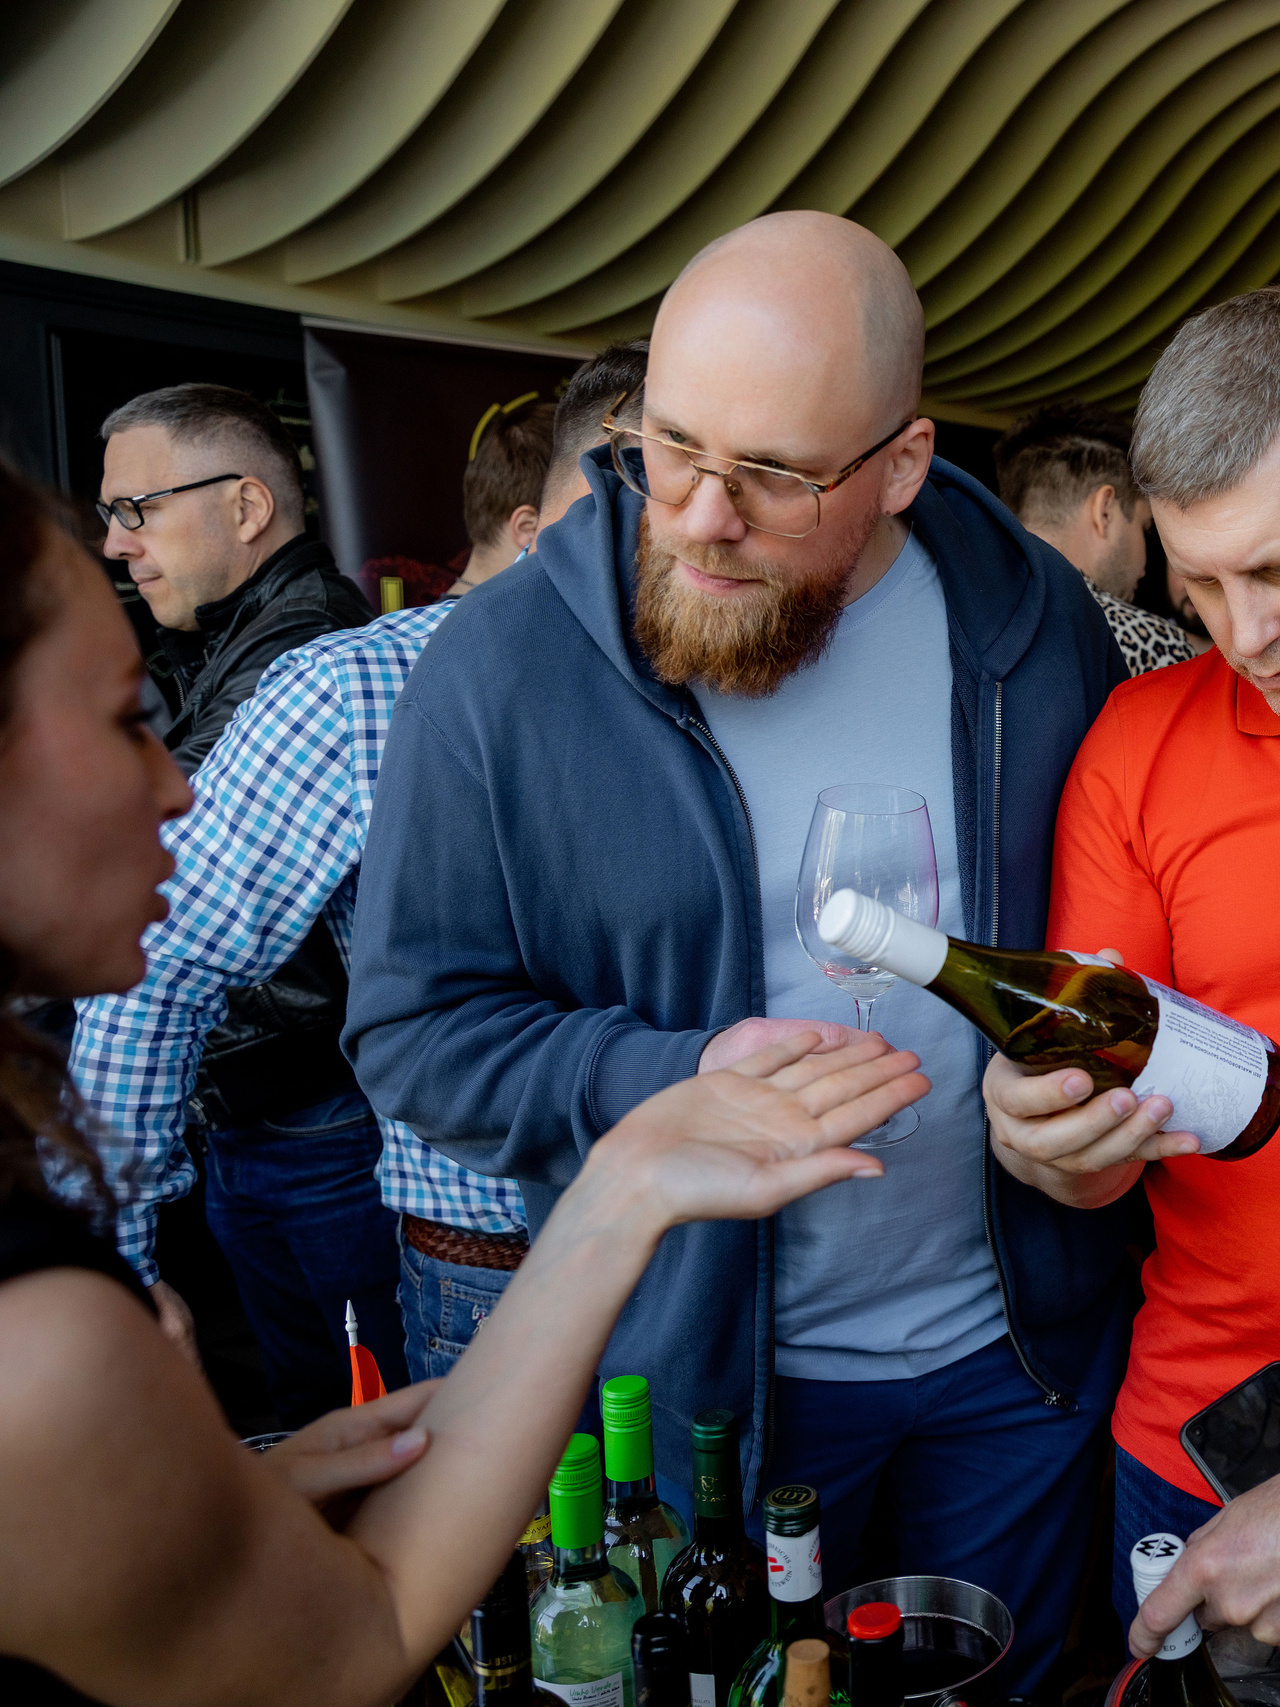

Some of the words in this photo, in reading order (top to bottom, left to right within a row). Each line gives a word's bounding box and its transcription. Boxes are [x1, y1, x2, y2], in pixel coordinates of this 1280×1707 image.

[1178, 1037, 1193, 1047] BLANC
[1193, 1044, 1219, 1059] SAUVIGNON
[1219, 1056, 1252, 1074] MARLBOROUGH
[1185, 1630, 1200, 1646] MOS
